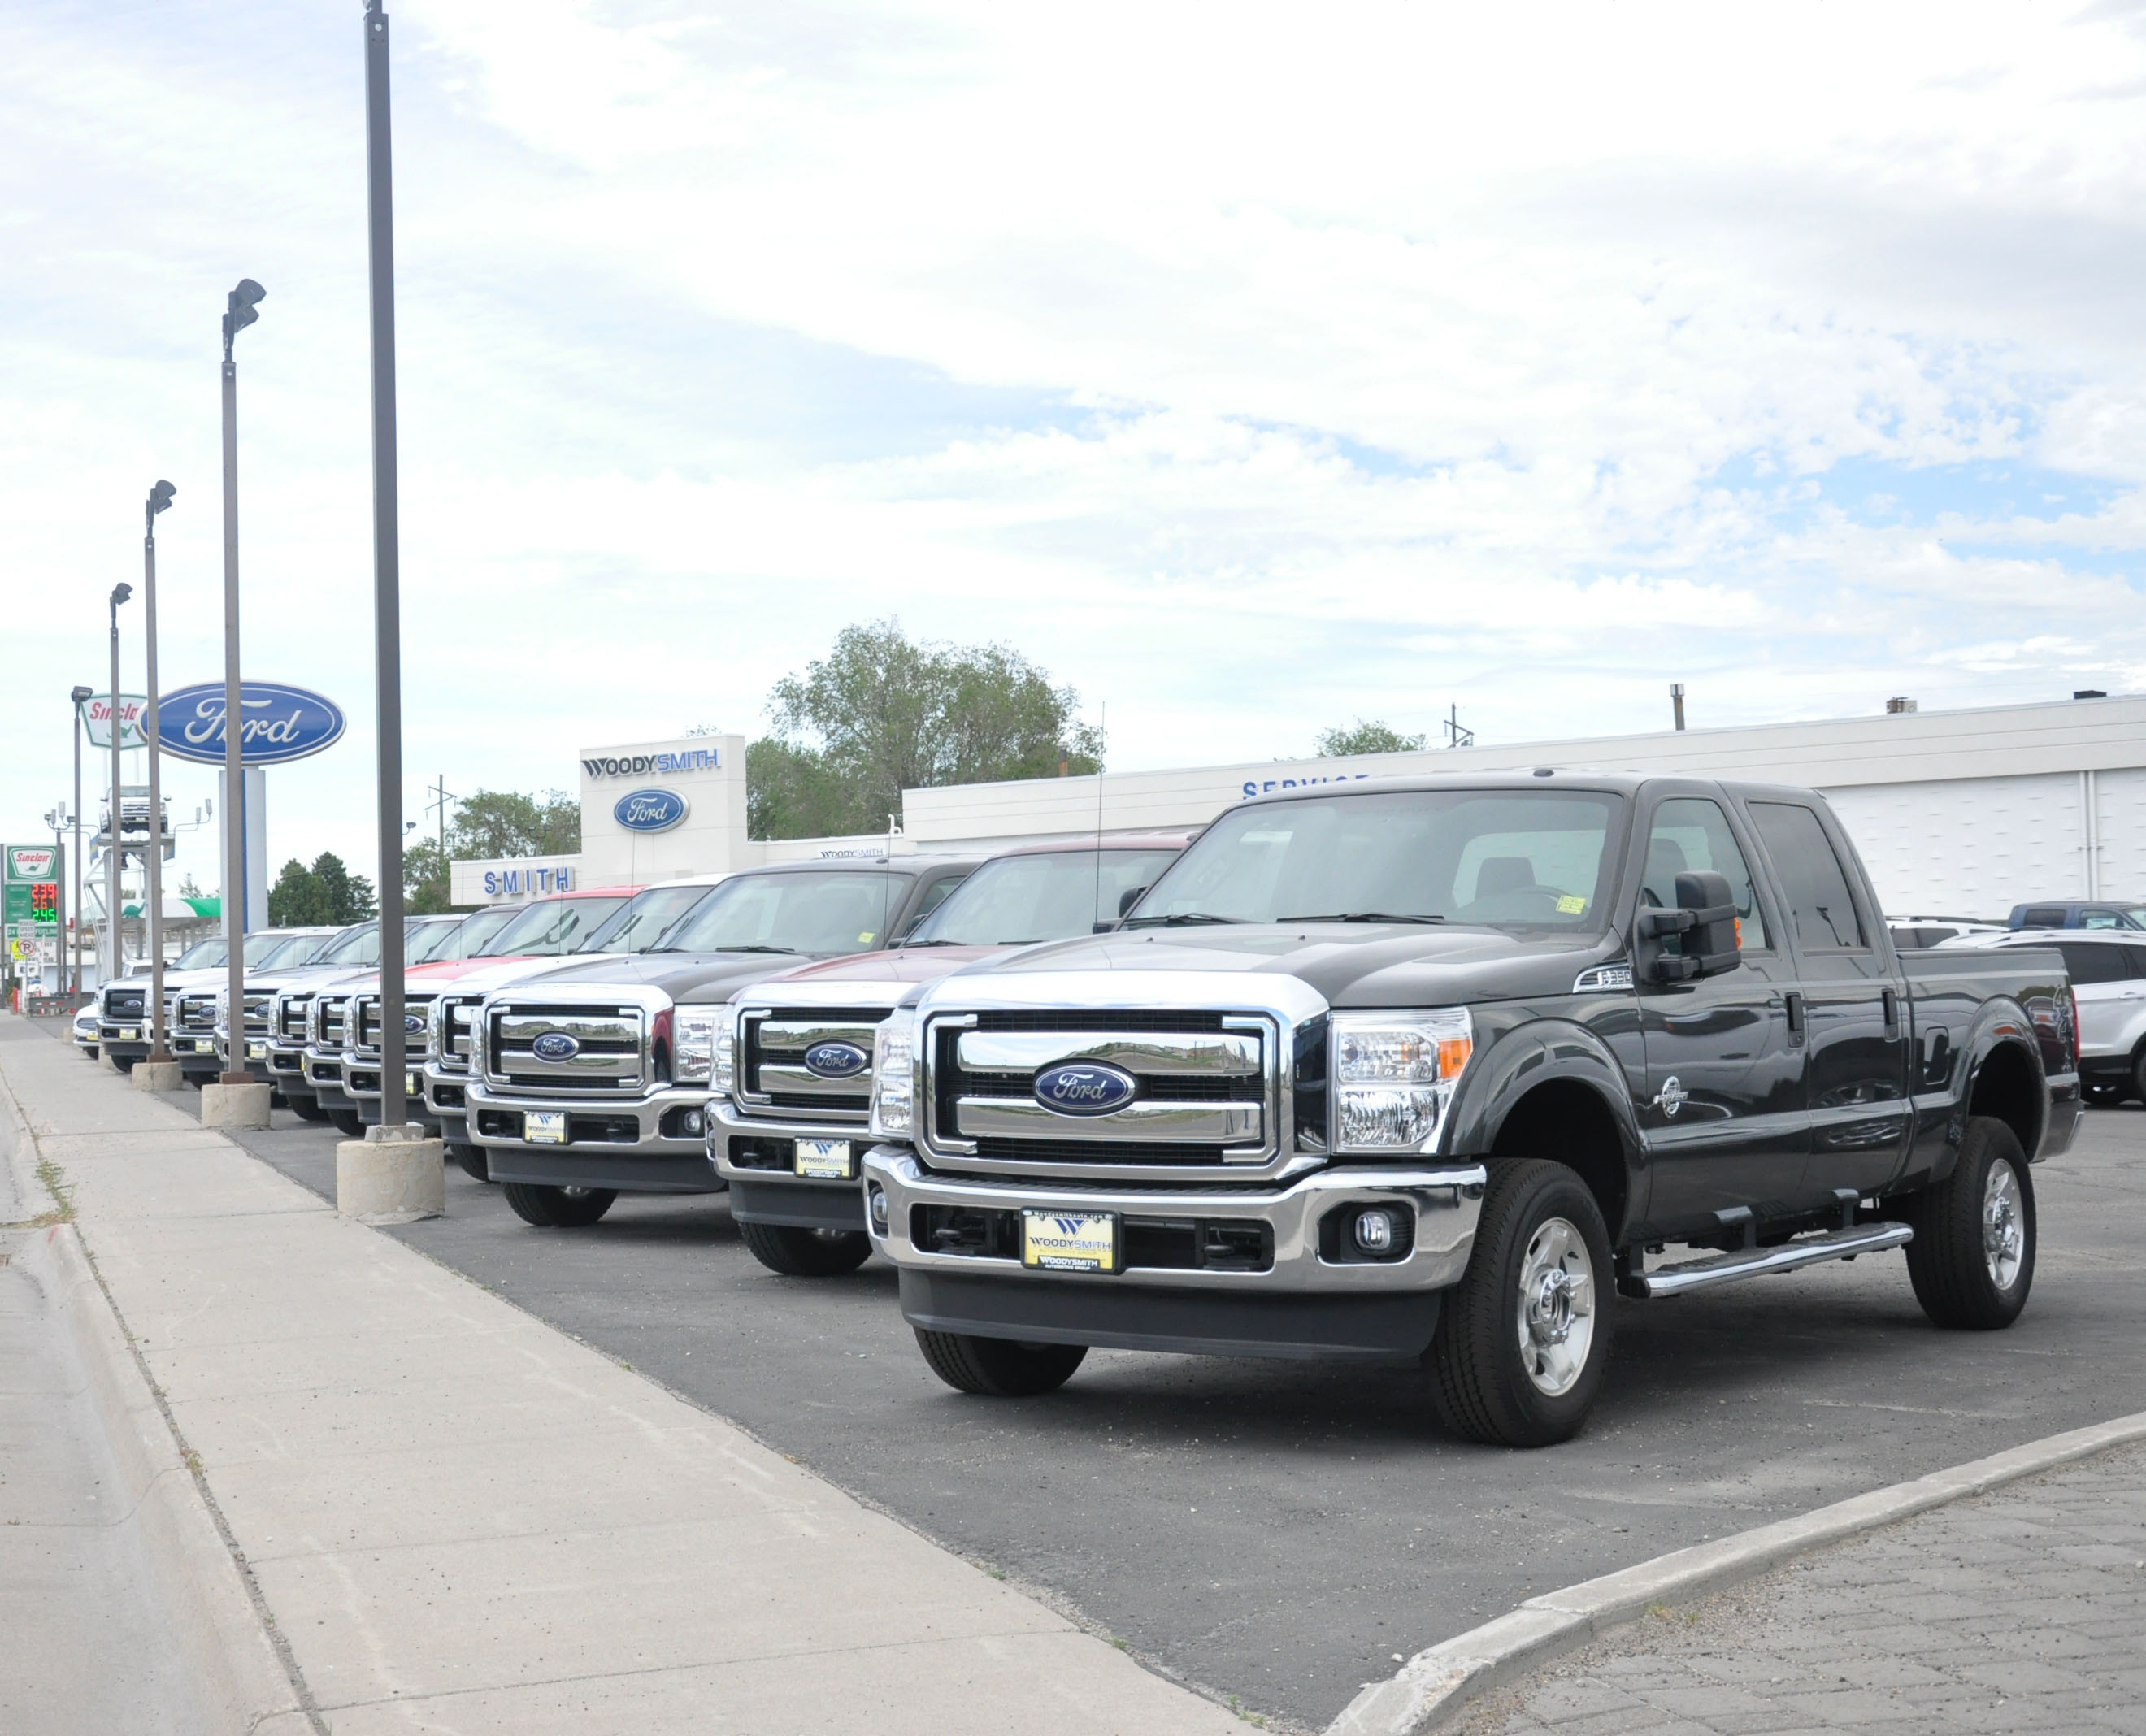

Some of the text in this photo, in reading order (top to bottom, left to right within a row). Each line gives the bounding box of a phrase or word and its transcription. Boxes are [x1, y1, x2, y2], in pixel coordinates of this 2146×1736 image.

[89, 701, 140, 721] Sinla
[627, 797, 668, 822] Ford
[16, 852, 50, 863] Sinclair
[484, 866, 569, 895] SMITH
[541, 1037, 566, 1053] Ford
[816, 1048, 849, 1067] Ford
[1053, 1072, 1107, 1099] Ford
